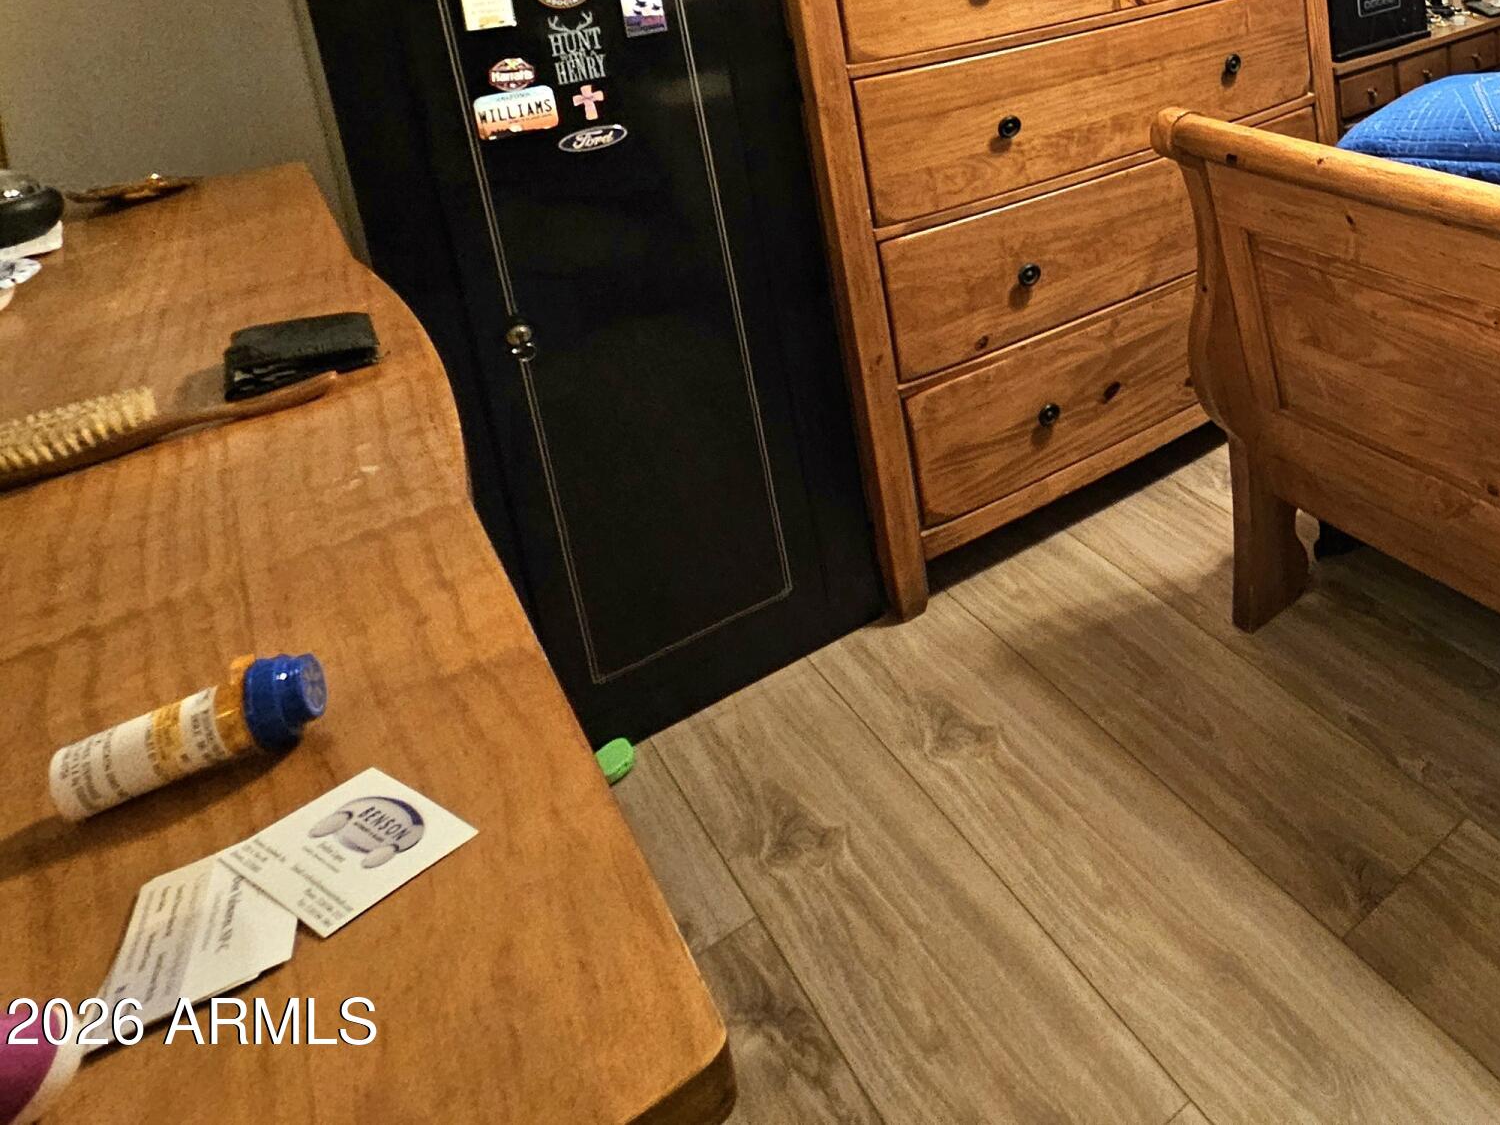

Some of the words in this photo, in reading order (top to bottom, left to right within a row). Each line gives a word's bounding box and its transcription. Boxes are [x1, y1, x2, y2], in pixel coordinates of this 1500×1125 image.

[548, 26, 602, 58] HUNT
[554, 53, 607, 85] HENRY
[478, 98, 553, 124] WILLIAMS
[573, 130, 614, 149] Ford
[358, 806, 411, 842] BENSON
